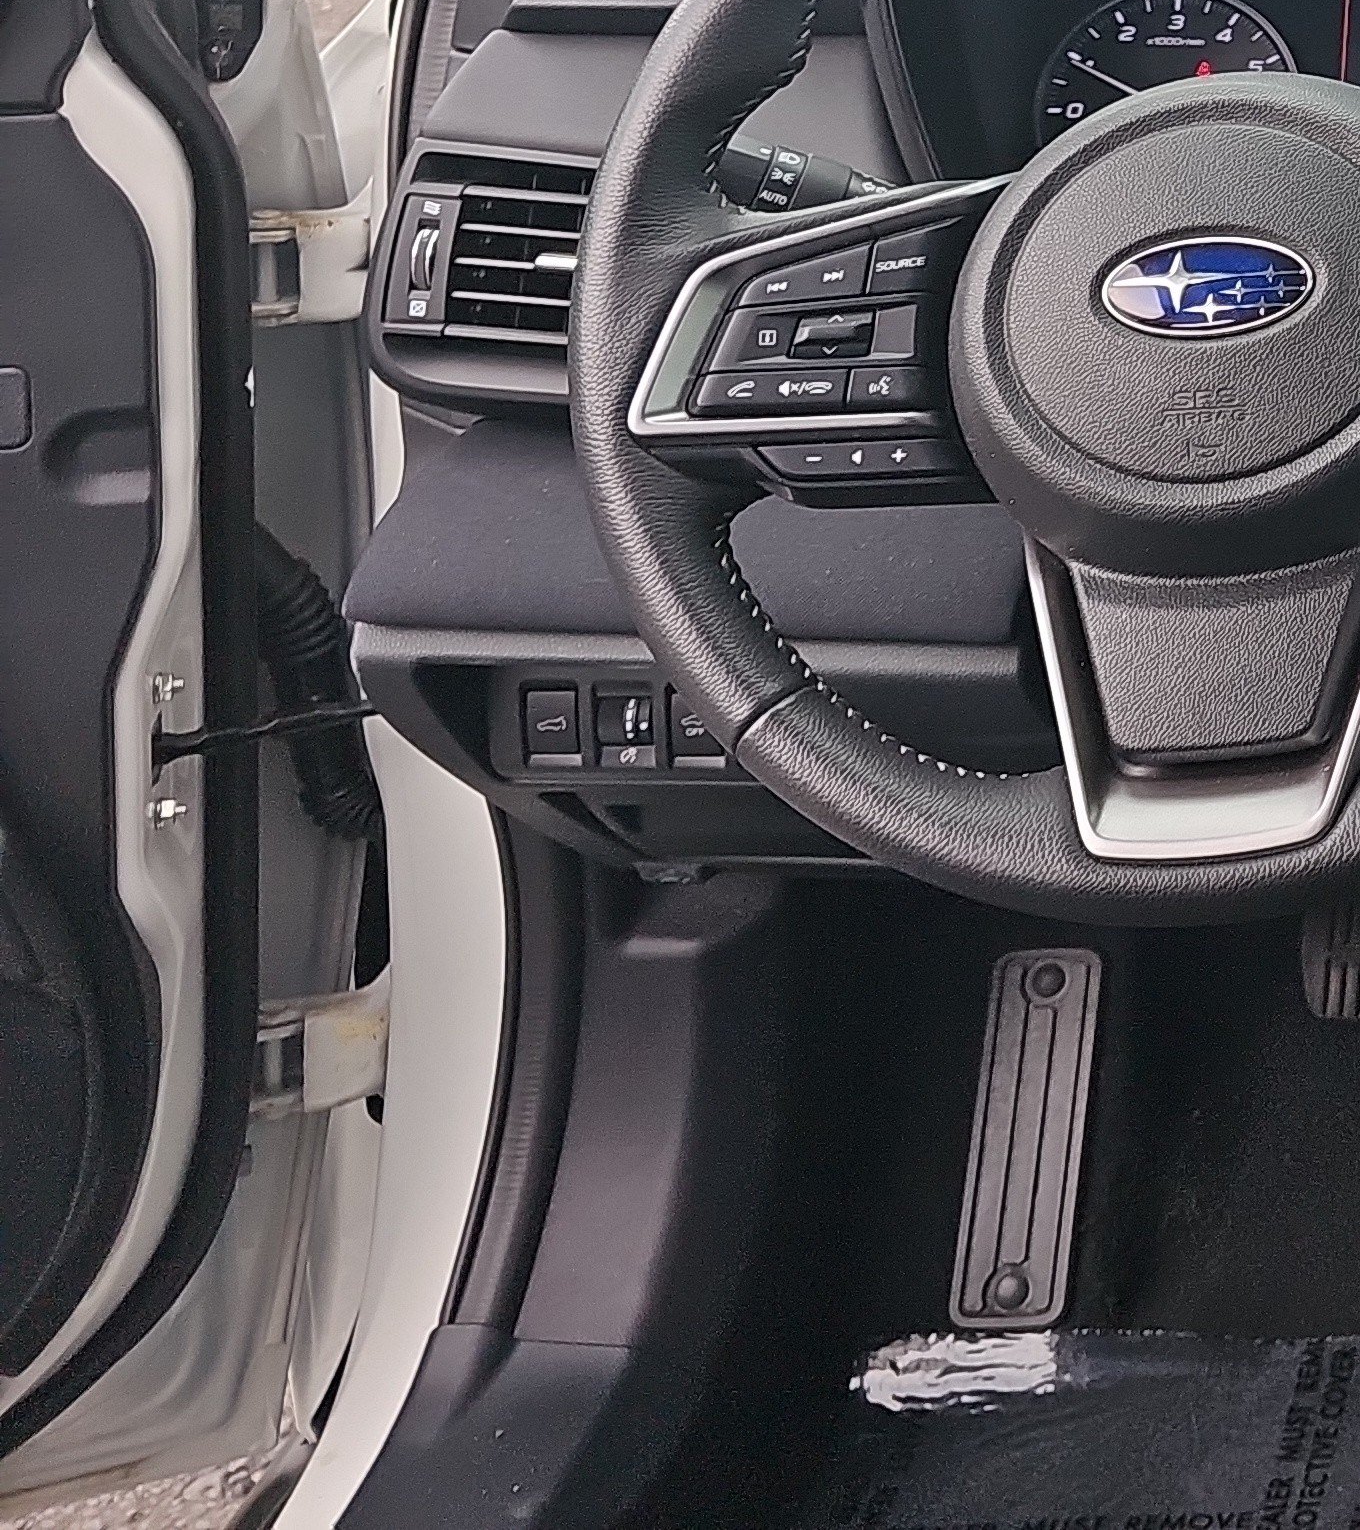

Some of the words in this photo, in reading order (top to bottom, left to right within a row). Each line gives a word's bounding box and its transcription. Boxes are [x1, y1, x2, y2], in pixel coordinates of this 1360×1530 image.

[1167, 13, 1186, 30] 3
[1117, 25, 1137, 42] 2
[1215, 28, 1233, 43] 4
[1065, 102, 1084, 119] 0
[758, 189, 788, 205] AUTO
[875, 256, 927, 273] SOURCE
[1292, 1425, 1340, 1528] OTECTIVE
[1256, 1475, 1295, 1530] EALER
